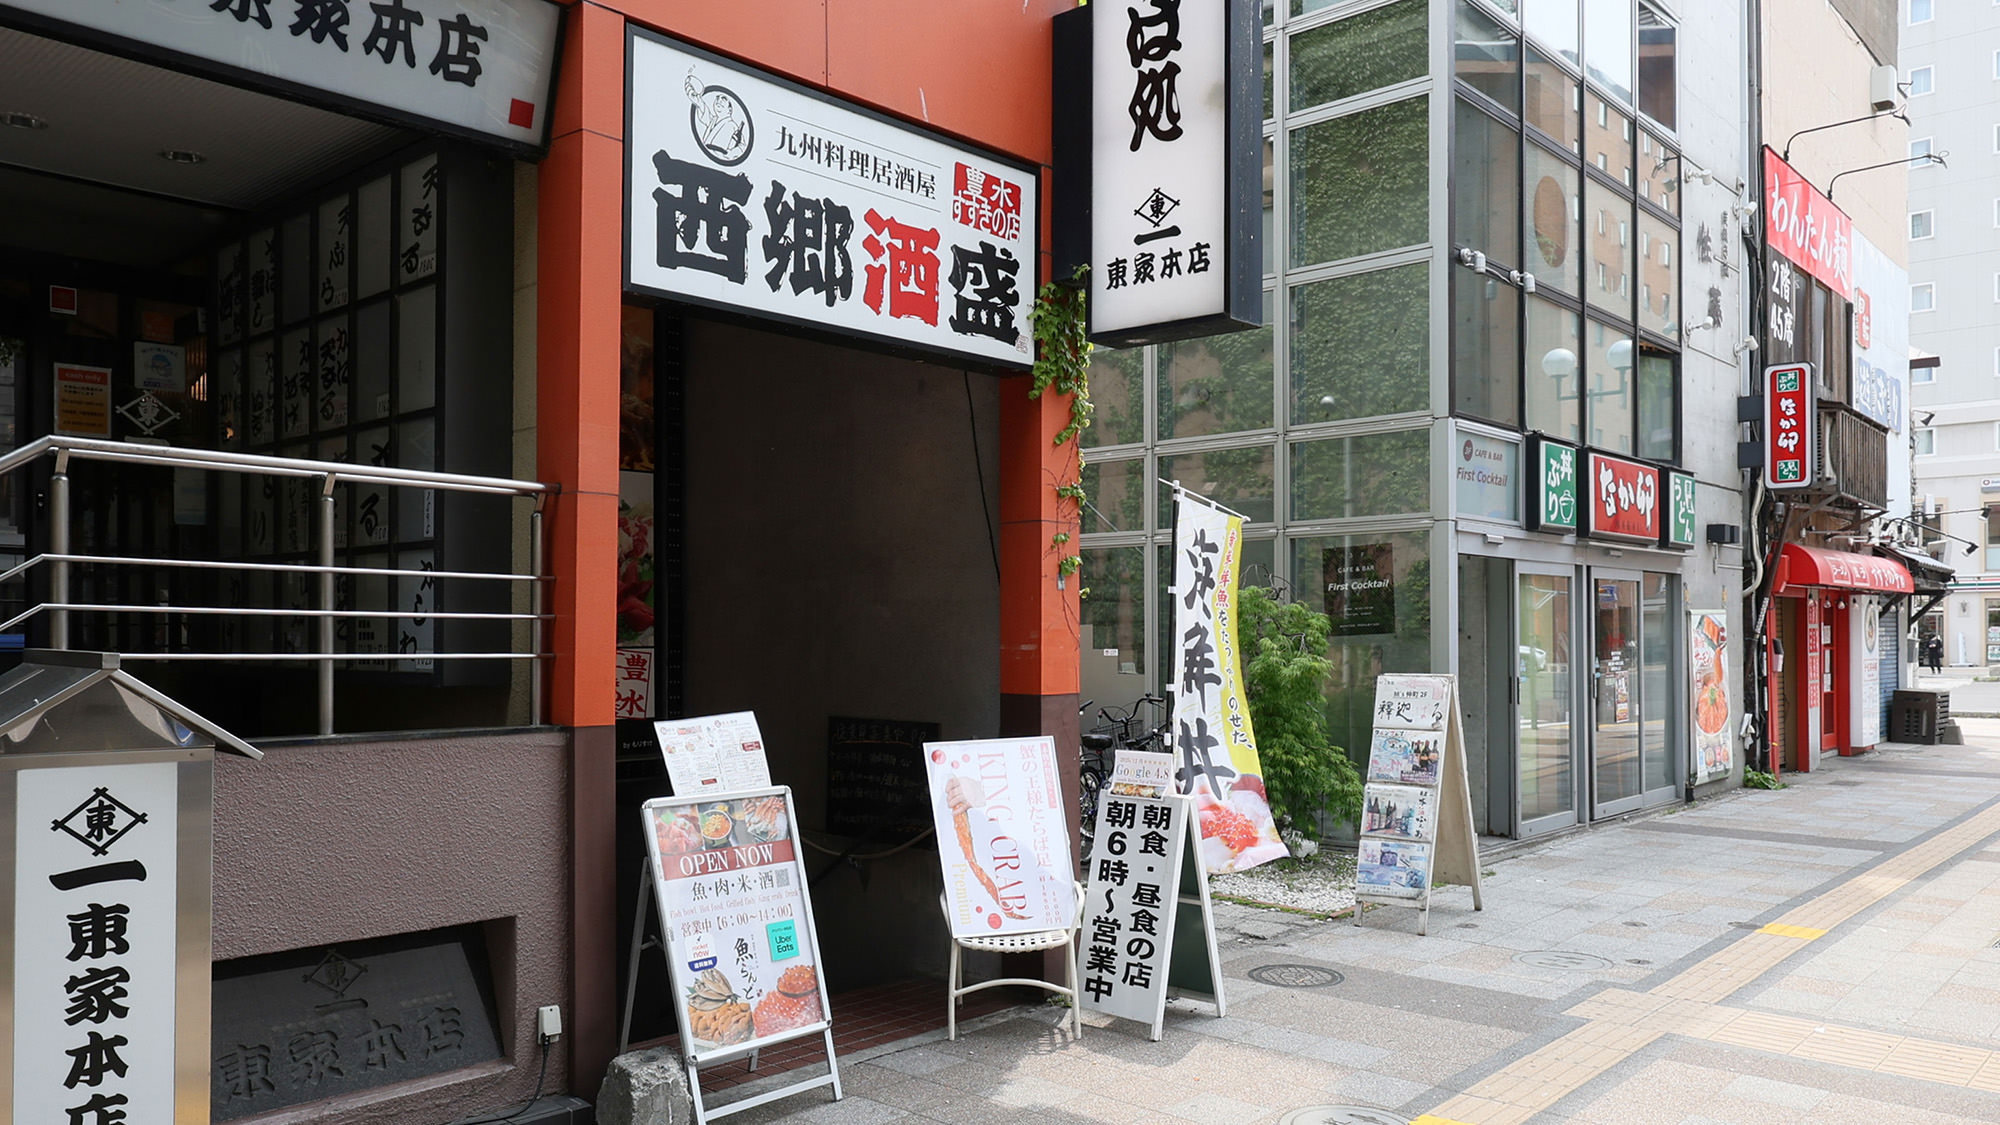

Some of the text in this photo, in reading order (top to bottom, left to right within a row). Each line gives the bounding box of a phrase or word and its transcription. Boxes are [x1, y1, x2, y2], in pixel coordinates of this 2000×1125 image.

[774, 124, 937, 201] 九州料理居酒屋
[962, 166, 1014, 209] 豊水
[952, 189, 1021, 243] すすきの店
[1771, 172, 1849, 291] わんたん麺
[651, 148, 1021, 345] 西郷酒盛
[1105, 241, 1211, 290] 東家本店
[1771, 259, 1792, 303] 2階
[1770, 302, 1794, 349] 45席
[1777, 397, 1800, 453] なか卯
[1456, 466, 1508, 487] First Cocktail
[1474, 448, 1488, 459] CAFE
[1599, 461, 1655, 533] なか卯
[1327, 578, 1390, 592] First Cocktail
[1337, 565, 1354, 574] CAFE
[1361, 564, 1375, 572] BAR
[621, 653, 649, 716] 豊水
[1115, 763, 1170, 779] Google 4.8
[977, 753, 1028, 913] KING CRAB
[679, 843, 774, 877] OPEN NOW
[691, 870, 775, 902] 魚・肉・米・酒
[951, 862, 972, 926] Premium
[1121, 804, 1172, 990] 朝食・昼食の店
[775, 935, 792, 945] Uber
[776, 943, 794, 954] Eats
[63, 903, 132, 1125] 東家本店
[215, 1006, 465, 1105] 東家本店
